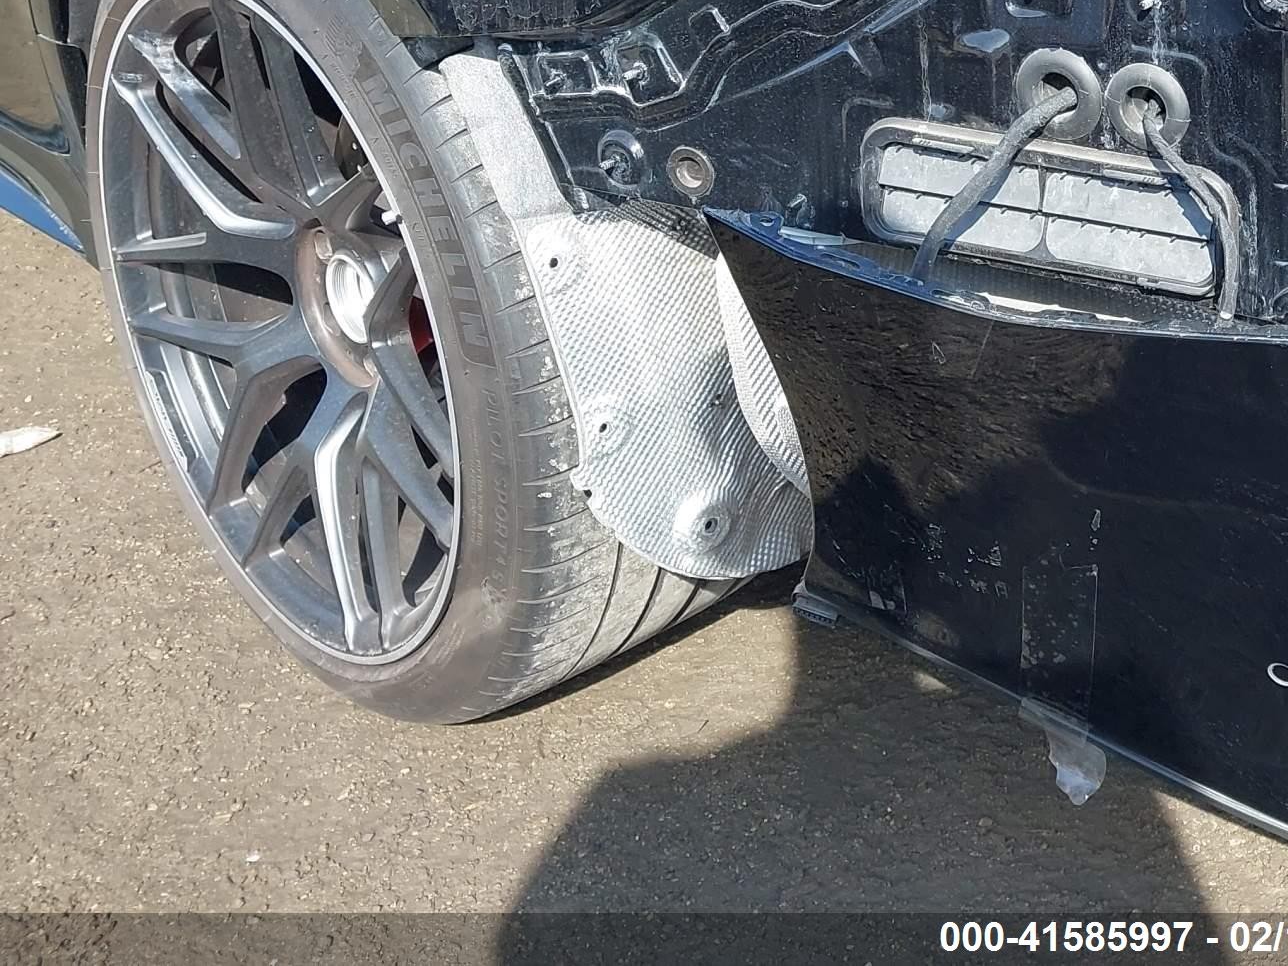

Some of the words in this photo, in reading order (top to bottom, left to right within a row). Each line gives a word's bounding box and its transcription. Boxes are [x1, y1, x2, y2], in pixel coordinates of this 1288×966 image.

[361, 74, 490, 348] MICHELIN
[481, 388, 505, 460] PILOT
[493, 477, 509, 552] SPORT
